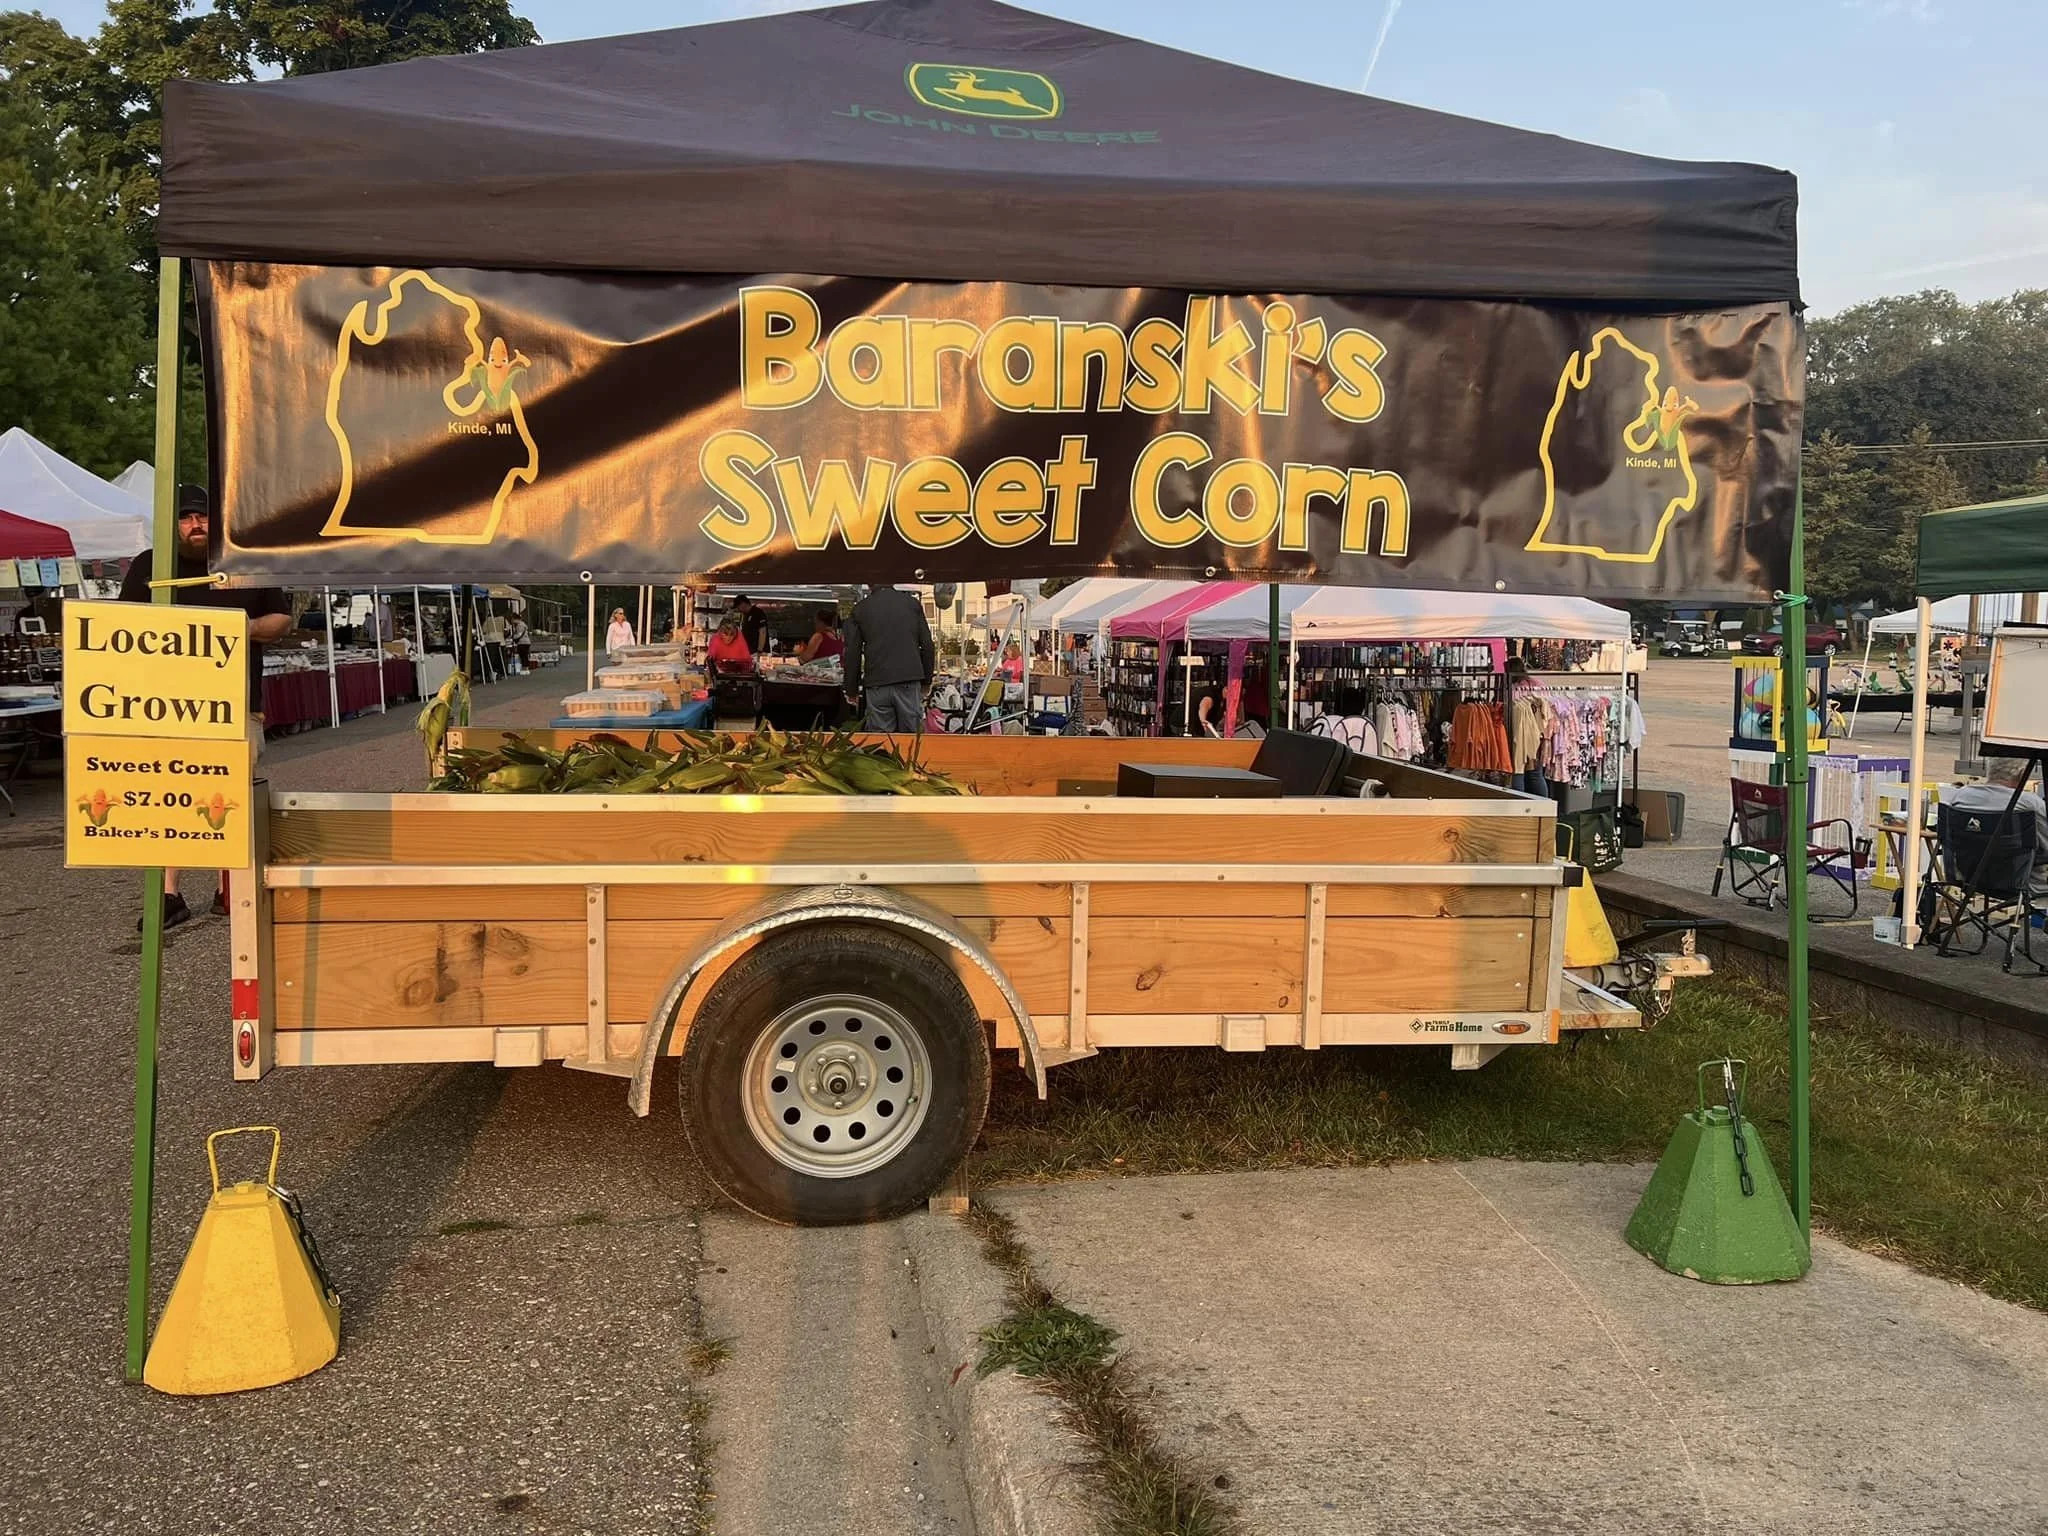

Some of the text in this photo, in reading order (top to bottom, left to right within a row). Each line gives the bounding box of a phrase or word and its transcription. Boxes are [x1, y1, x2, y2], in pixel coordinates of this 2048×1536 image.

[832, 104, 1162, 144] JOHN DEERE
[739, 286, 1389, 423] Baranski's
[447, 421, 512, 436] Kinde, MI
[1625, 457, 1677, 469] Kinde, MI
[698, 430, 1411, 557] Sweet Corn
[75, 616, 239, 668] Locally
[79, 683, 234, 724] Grown
[86, 757, 230, 776] Sweet Corn
[123, 791, 193, 808] $7.00
[84, 826, 225, 841] Baker's Dozen
